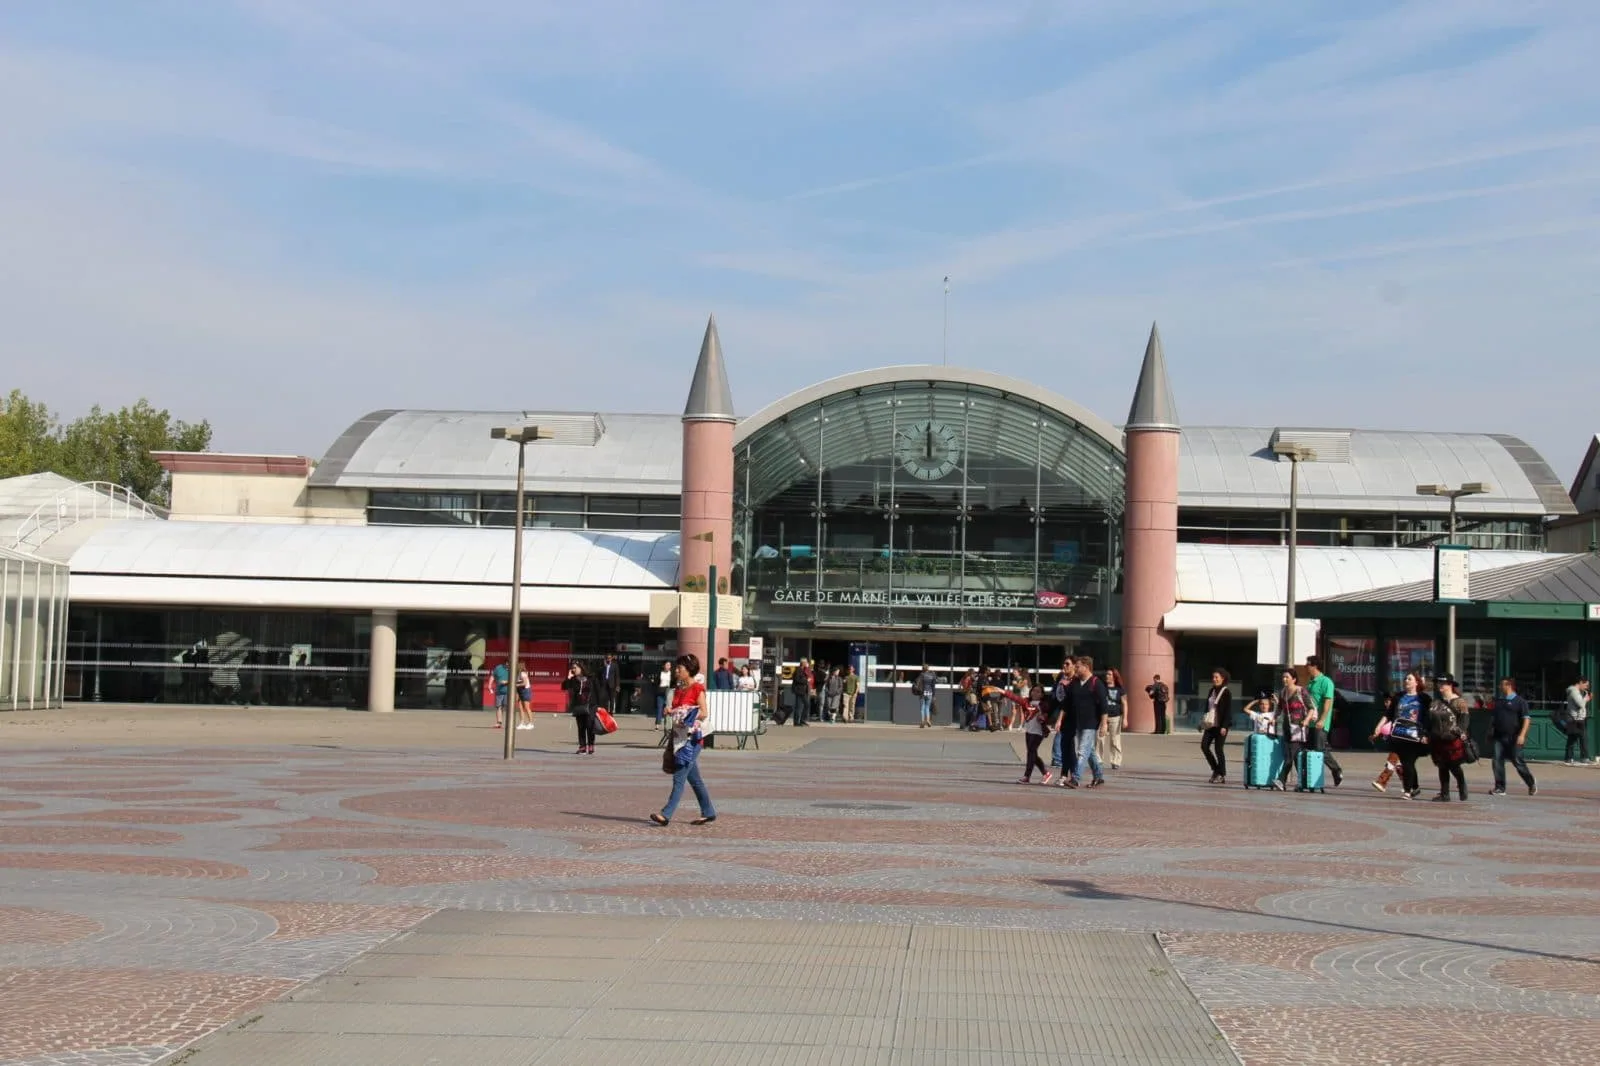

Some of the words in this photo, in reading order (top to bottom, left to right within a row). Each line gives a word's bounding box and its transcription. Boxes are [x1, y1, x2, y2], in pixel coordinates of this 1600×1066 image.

[774, 590, 811, 601] GARE
[817, 591, 833, 602] DE
[840, 592, 889, 604] MARNE
[895, 593, 909, 605] LA
[916, 592, 961, 606] VALLÉE
[968, 595, 1020, 607] CHESSY
[1039, 596, 1065, 605] SNCF
